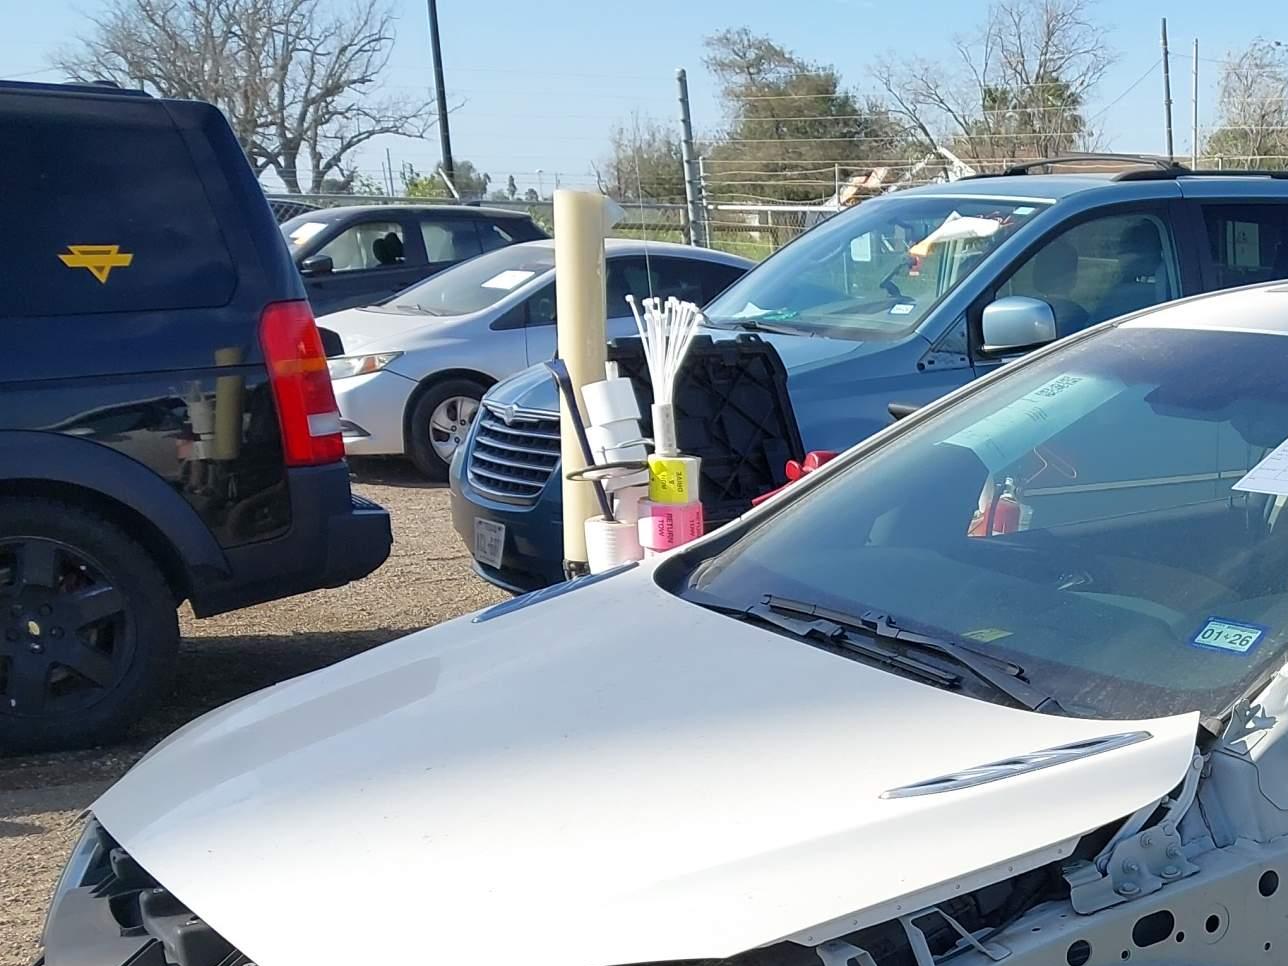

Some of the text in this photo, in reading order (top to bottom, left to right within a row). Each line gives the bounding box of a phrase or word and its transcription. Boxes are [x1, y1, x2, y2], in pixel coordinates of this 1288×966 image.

[676, 471, 684, 493] DRIVE
[666, 513, 674, 544] RETURN
[1201, 628, 1224, 641] 01
[1228, 633, 1253, 647] 26
